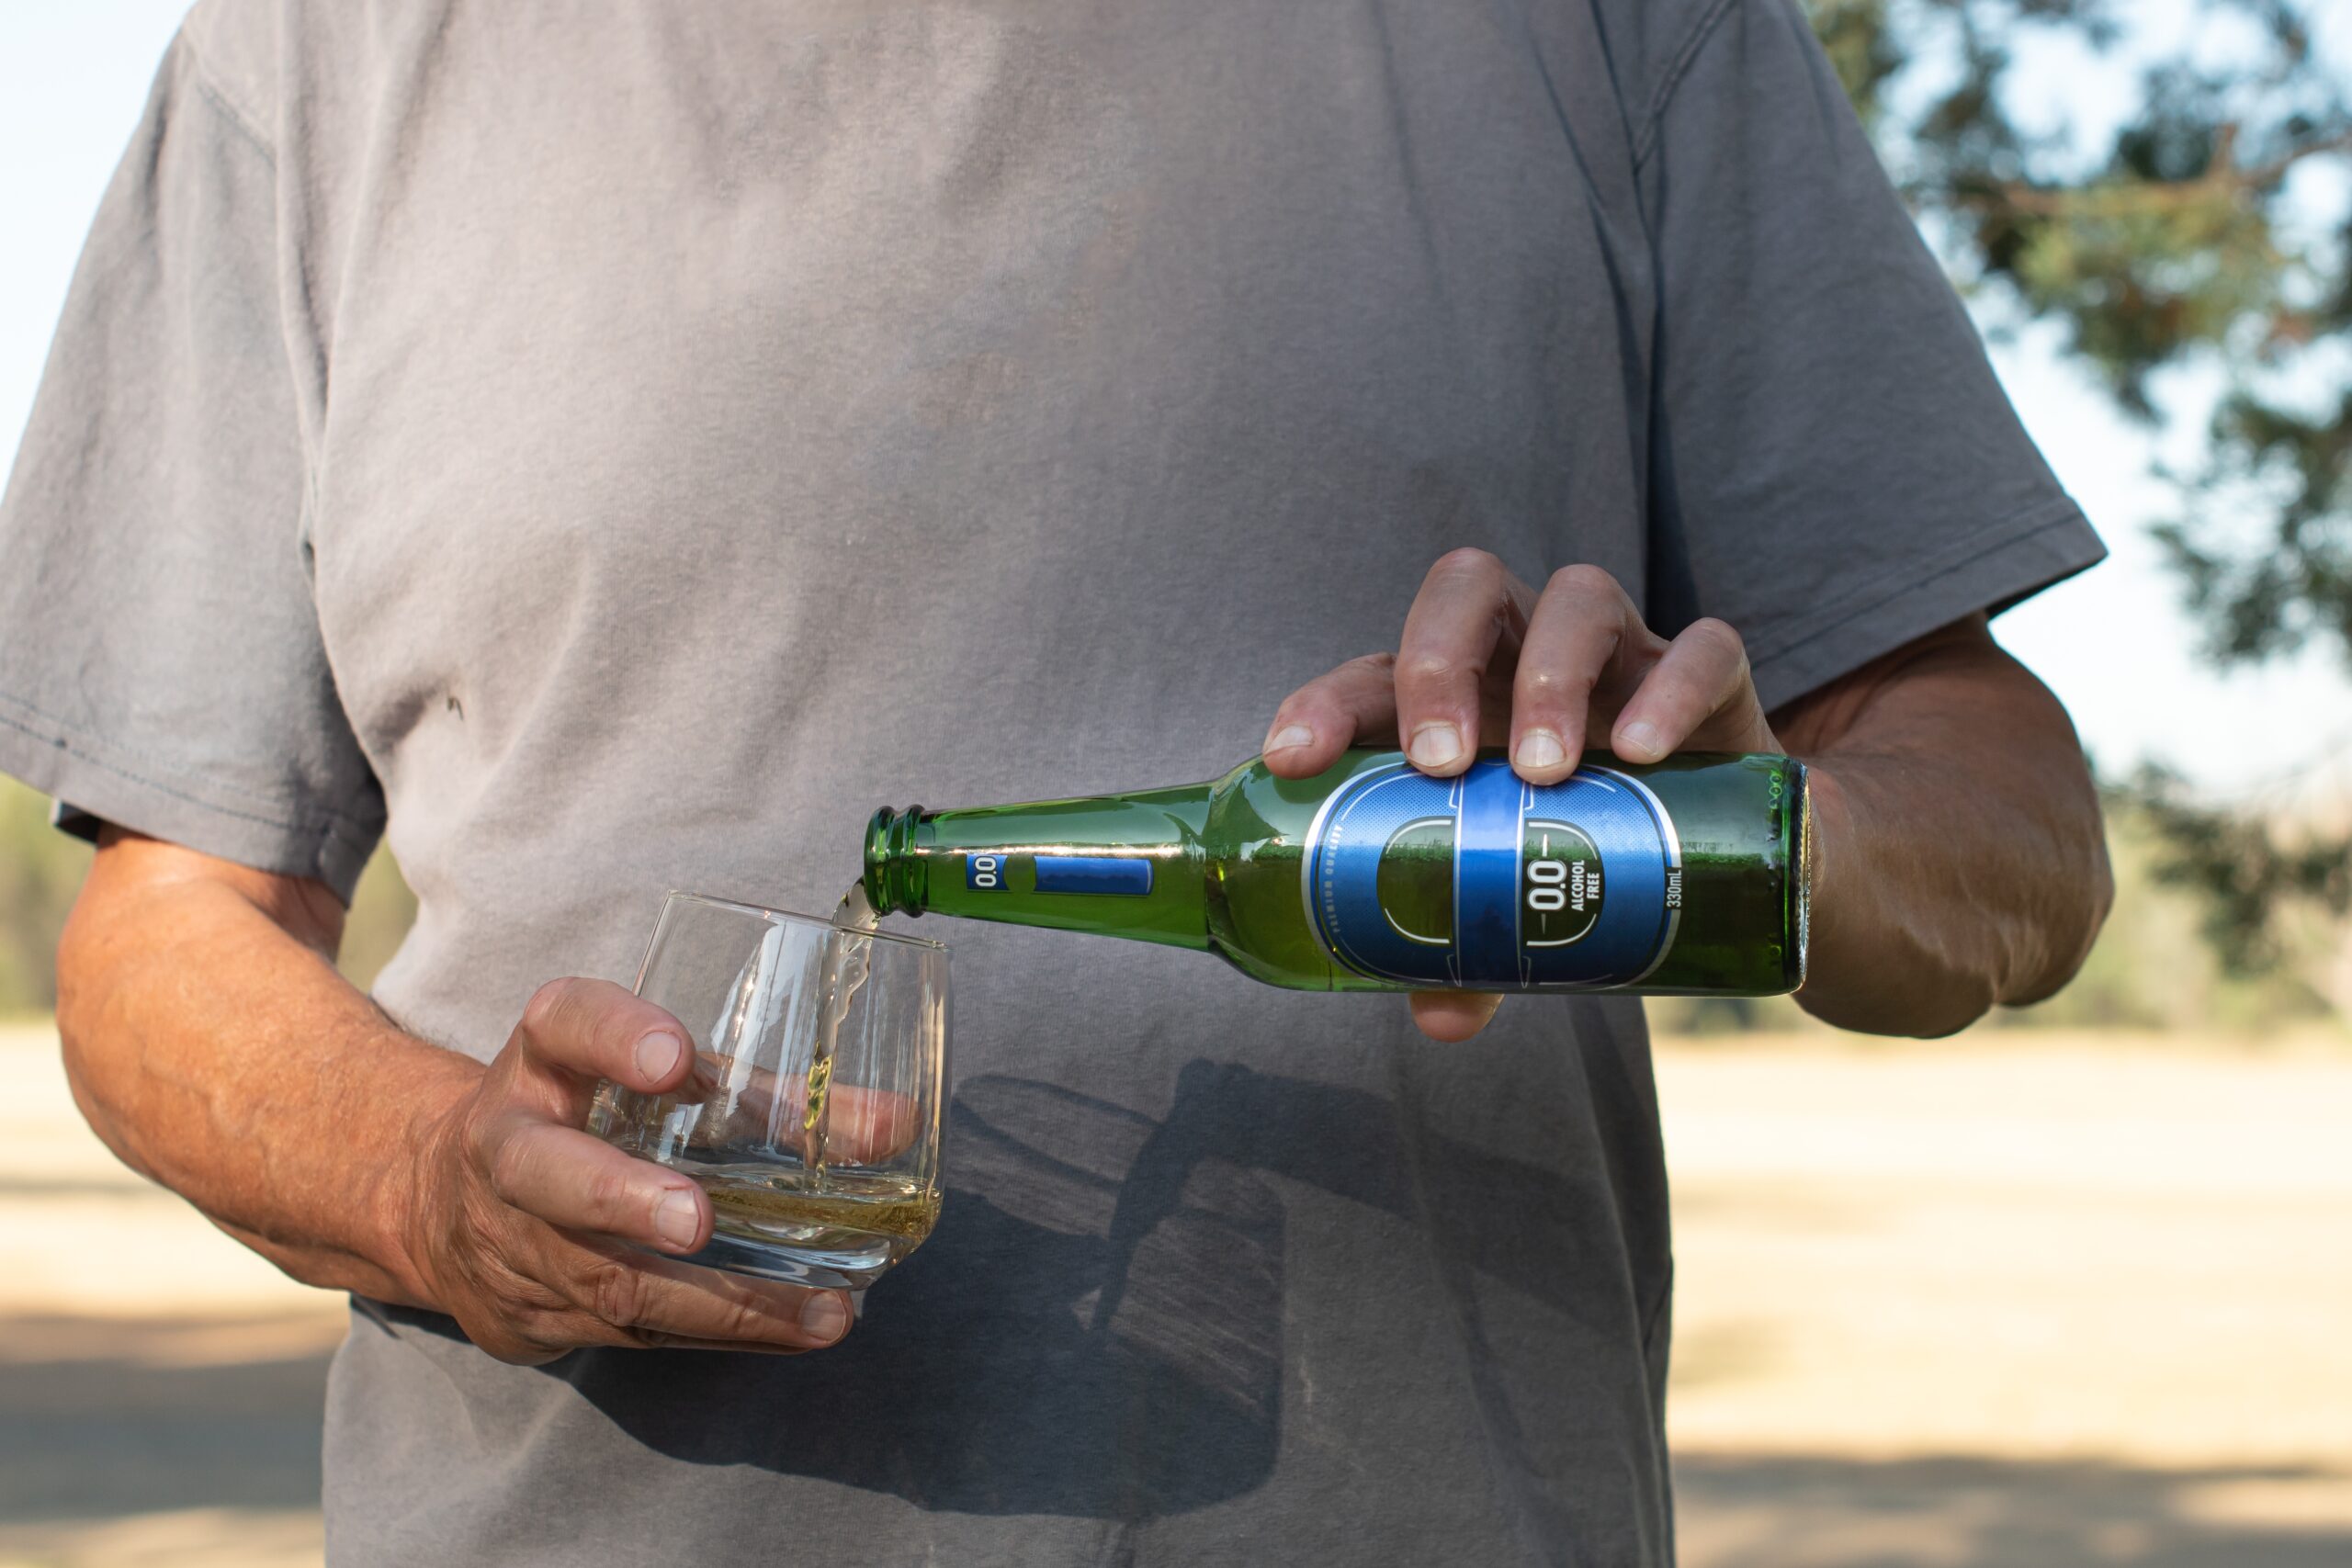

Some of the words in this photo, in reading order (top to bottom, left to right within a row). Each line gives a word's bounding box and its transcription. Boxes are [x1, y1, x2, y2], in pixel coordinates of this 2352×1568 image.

[975, 856, 997, 886] 0.0
[1325, 825, 1342, 875] QUALITY
[1324, 880, 1340, 933] PREMIUM
[1528, 860, 1566, 911] 0.0
[1572, 860, 1585, 911] ALCOHOL
[1587, 873, 1600, 899] FREE
[1667, 870, 1681, 908] 330mL
